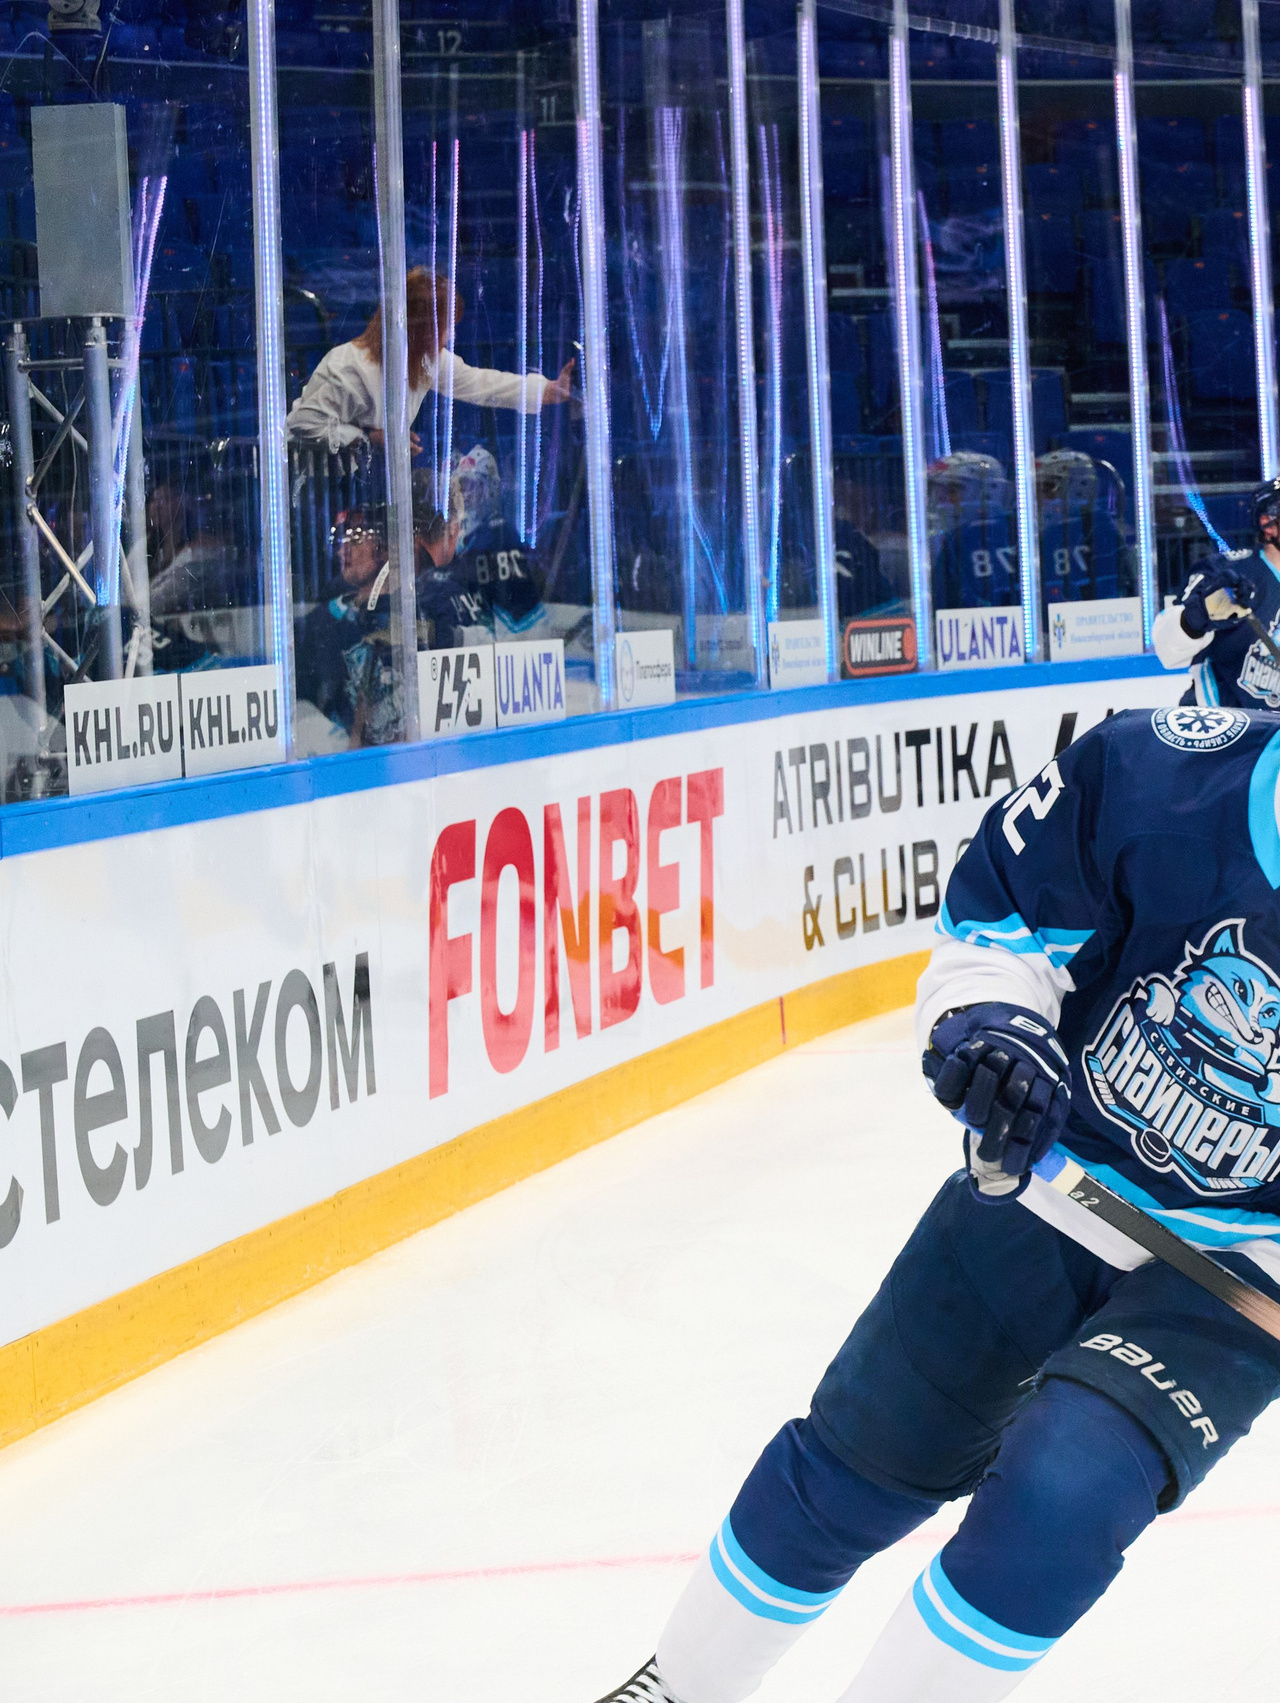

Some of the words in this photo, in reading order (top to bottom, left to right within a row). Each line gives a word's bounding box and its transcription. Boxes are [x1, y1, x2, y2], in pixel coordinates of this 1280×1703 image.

[850, 630, 903, 663] WINLINE
[939, 615, 1022, 662] ULANTA
[189, 688, 279, 751] KHL.RU
[497, 652, 564, 716] ULANTA
[72, 700, 174, 767] KHL.RU
[772, 718, 1019, 840] ATRIBUTIKA
[1002, 757, 1066, 856] 2
[802, 864, 826, 952] &
[833, 838, 942, 941] CLUB
[429, 766, 725, 1101] FONBET
[1149, 1031, 1251, 1117] СИБИРСКИЕ
